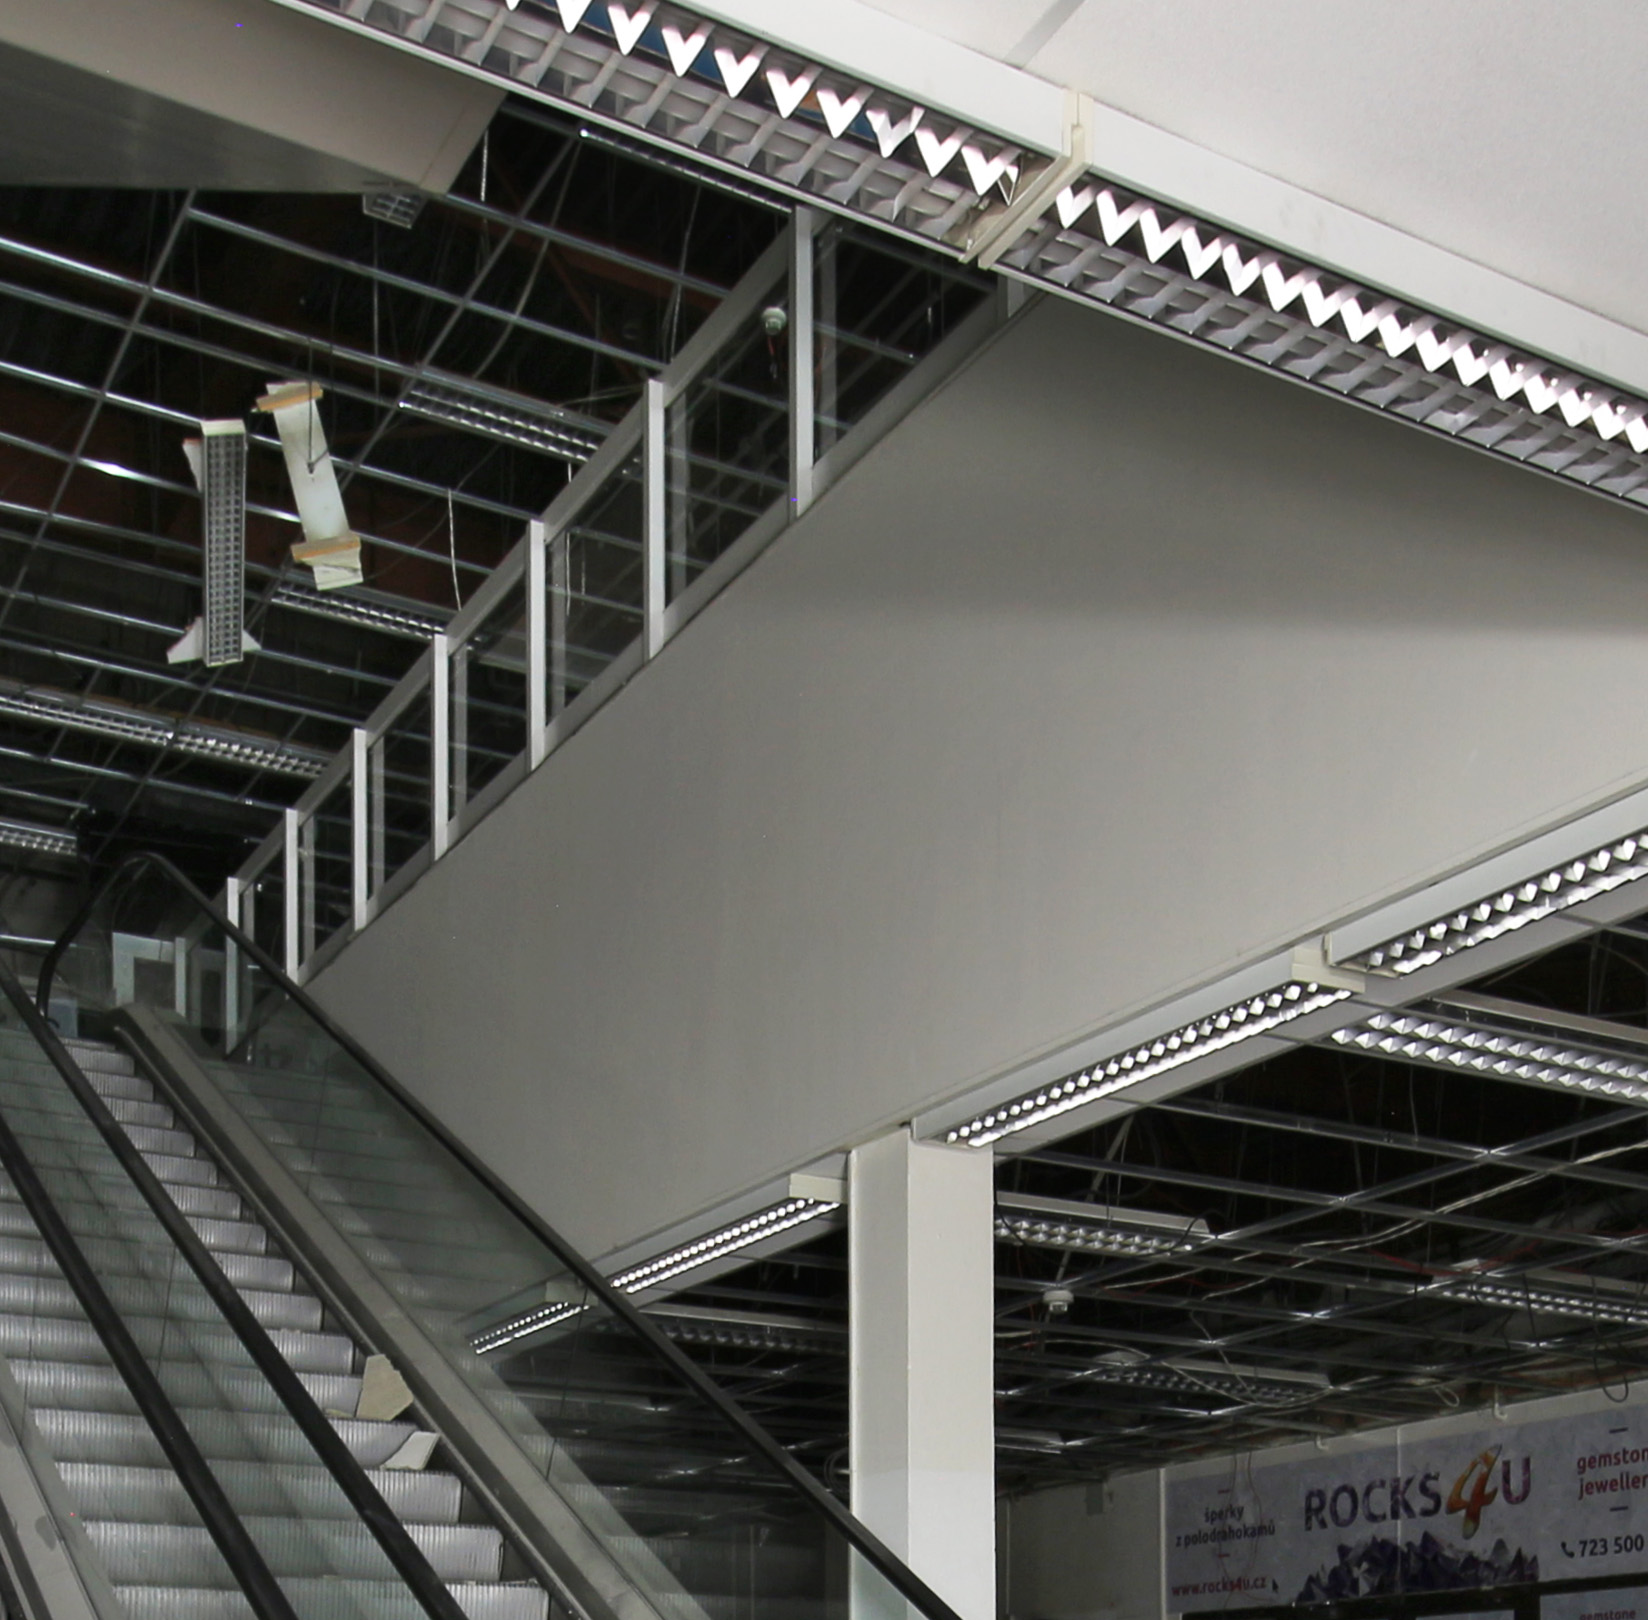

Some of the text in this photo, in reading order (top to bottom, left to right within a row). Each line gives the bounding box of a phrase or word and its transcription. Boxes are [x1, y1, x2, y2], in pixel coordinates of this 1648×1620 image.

[1304, 1444, 1531, 1540] ROCKS4U
[1175, 1521, 1276, 1549] z polodrahokamů
[1579, 1539, 1608, 1557] 723
[1614, 1535, 1644, 1554] 500
[1172, 1577, 1267, 1596] www.rocks4u.cz
